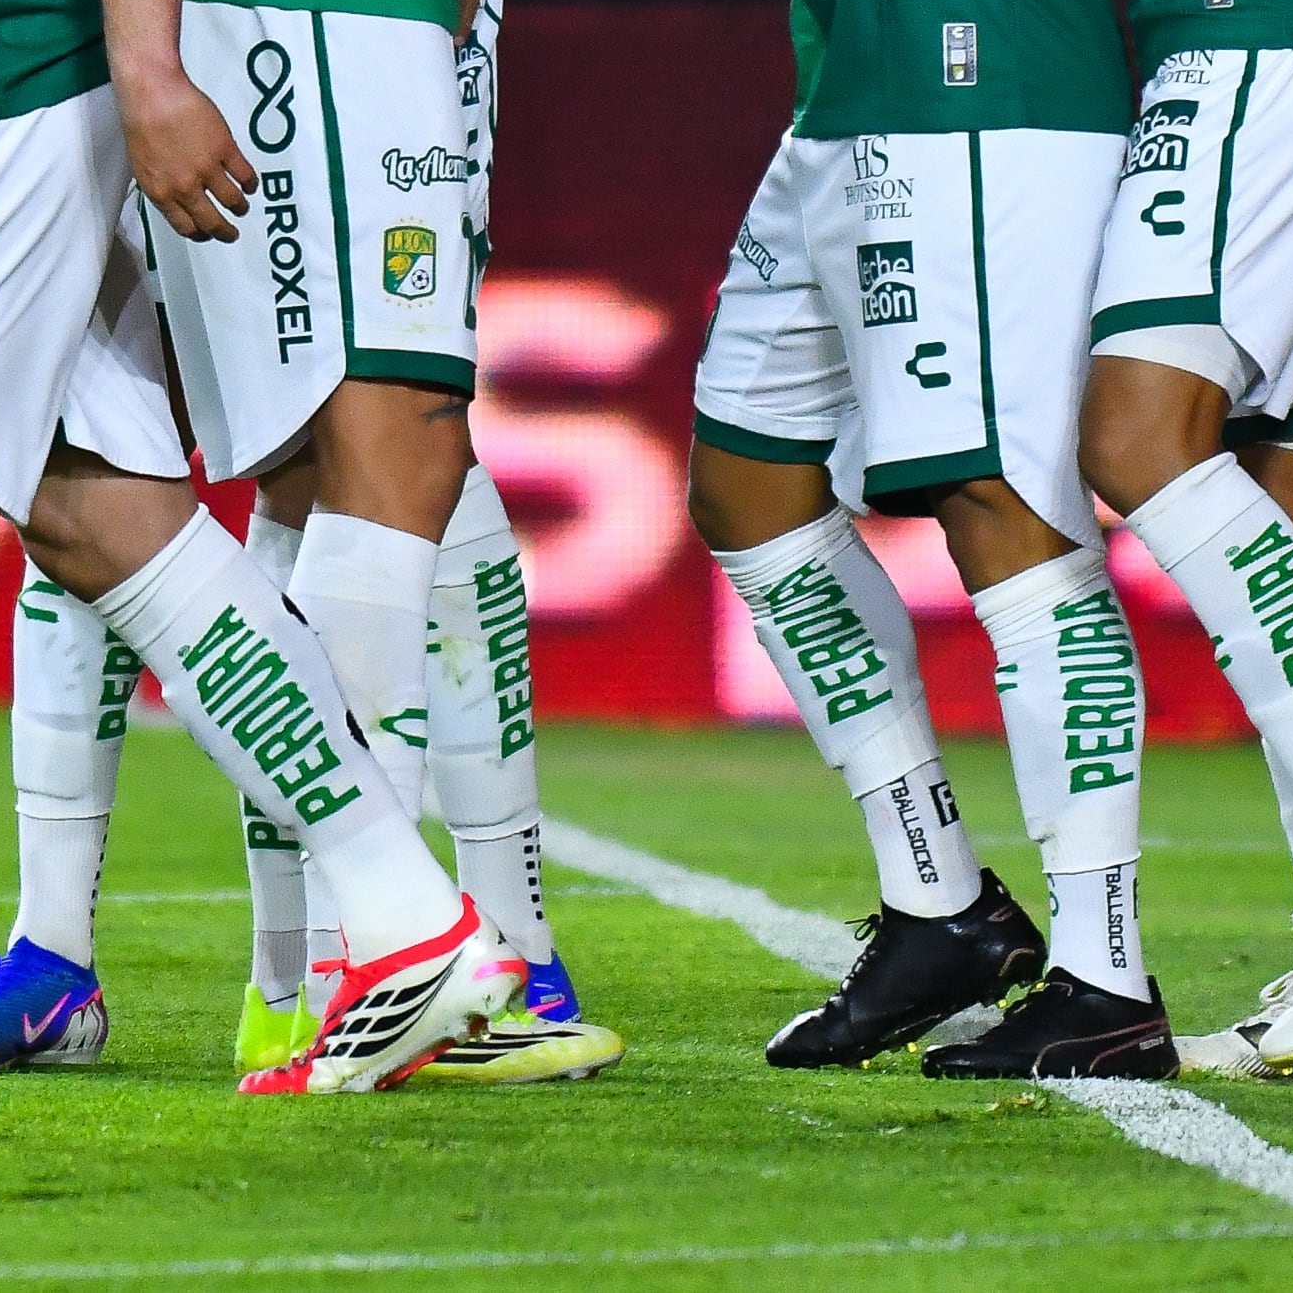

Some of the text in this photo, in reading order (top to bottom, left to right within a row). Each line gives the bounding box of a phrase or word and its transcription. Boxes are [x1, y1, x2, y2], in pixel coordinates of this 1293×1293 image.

[381, 147, 418, 193] La
[853, 135, 889, 181] HS
[260, 169, 314, 365] BROXEL
[179, 604, 363, 826] PERDURA
[1054, 588, 1136, 794] PERDURA
